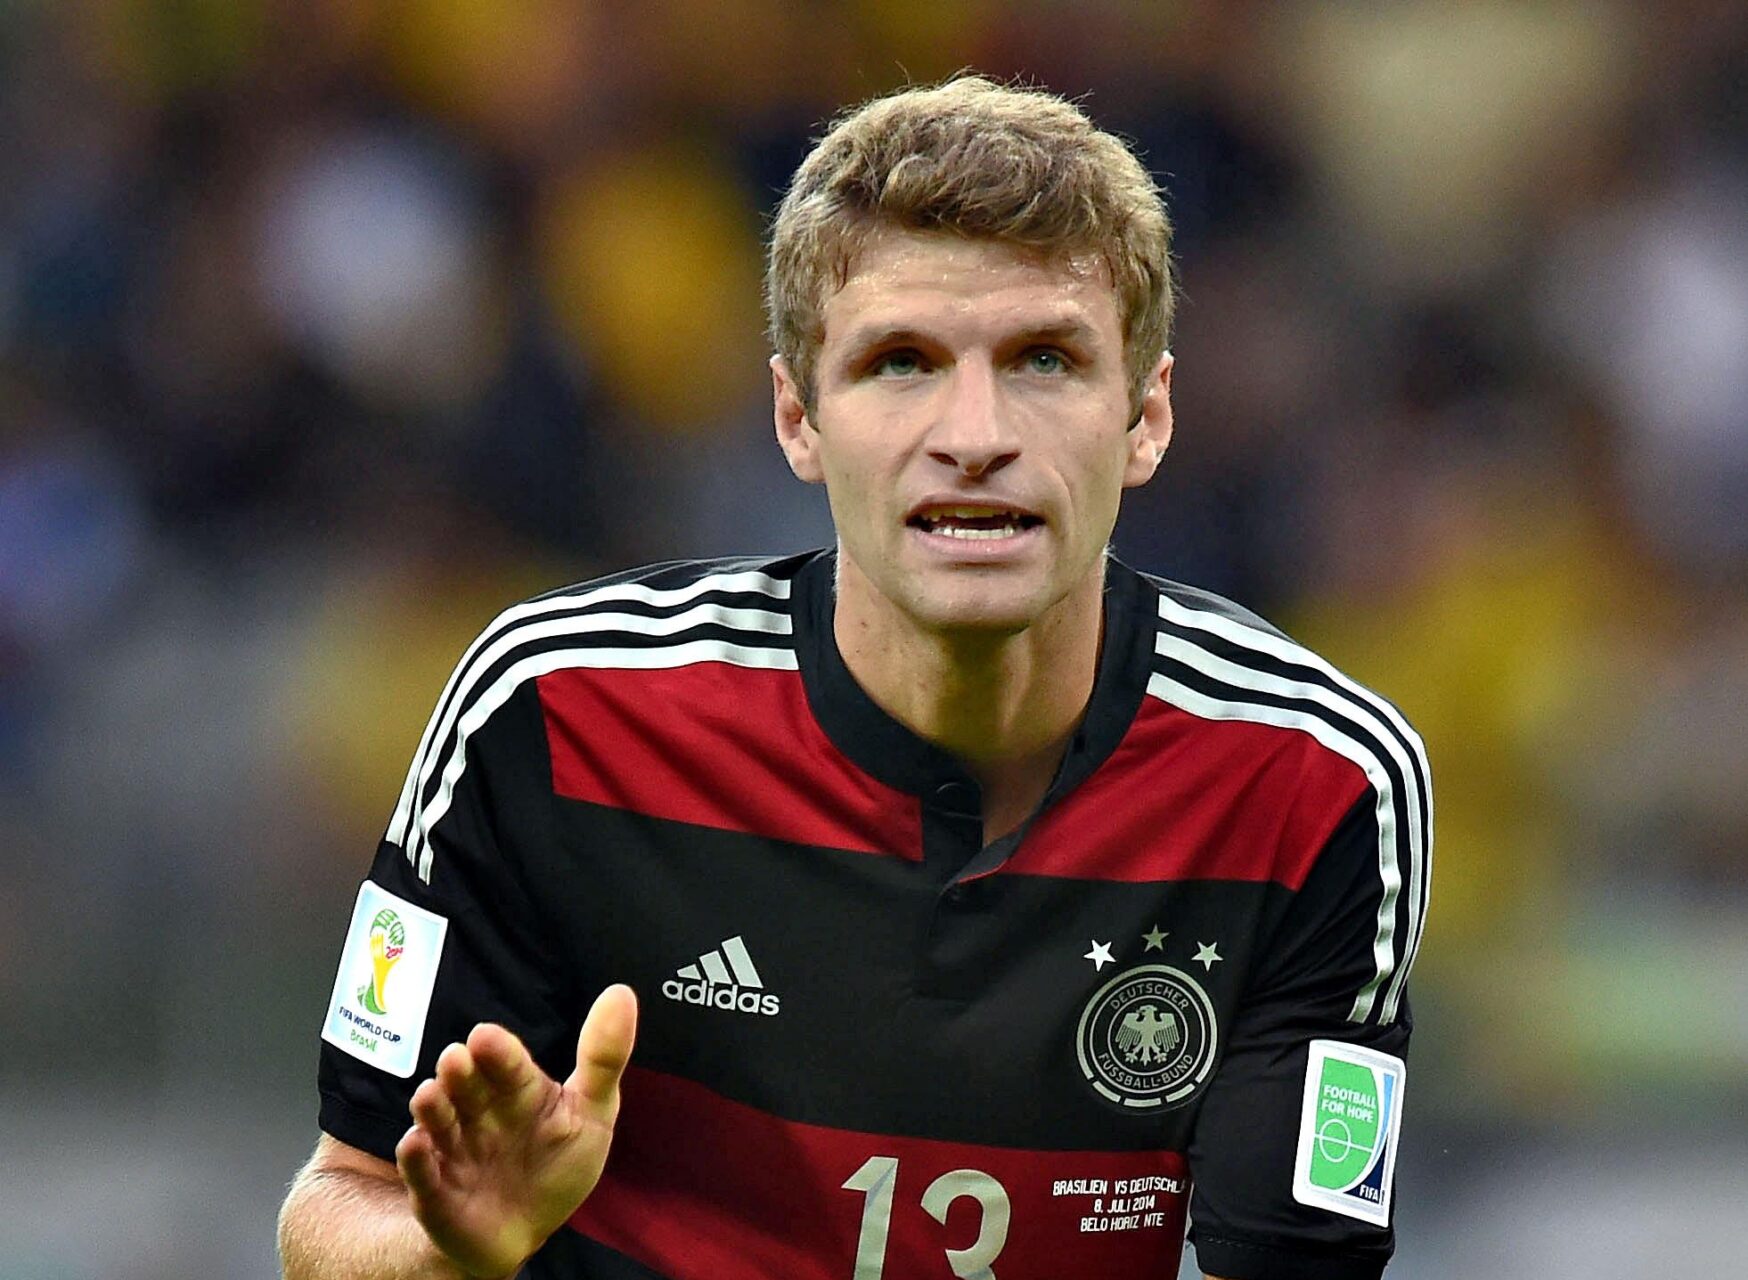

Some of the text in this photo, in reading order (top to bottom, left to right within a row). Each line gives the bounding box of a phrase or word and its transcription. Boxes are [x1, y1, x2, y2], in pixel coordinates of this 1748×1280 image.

[662, 979, 780, 1016] adidas
[1109, 982, 1190, 1011] DEUTSCHER
[339, 1006, 353, 1022] FIFA
[354, 1014, 382, 1036] WORLD
[383, 1030, 401, 1043] CUP
[1098, 1052, 1194, 1089] FUSSBALL-BUND
[1323, 1084, 1376, 1109] FOOTBALL
[1321, 1099, 1374, 1124] FOR HOPE
[1053, 1179, 1108, 1196] BRASILIEN
[1114, 1180, 1128, 1195] VS
[1359, 1184, 1380, 1202] FIFA
[1107, 1198, 1131, 1214] JULI
[1132, 1194, 1156, 1212] 2014
[1080, 1212, 1165, 1232] BELO HORIZNTE
